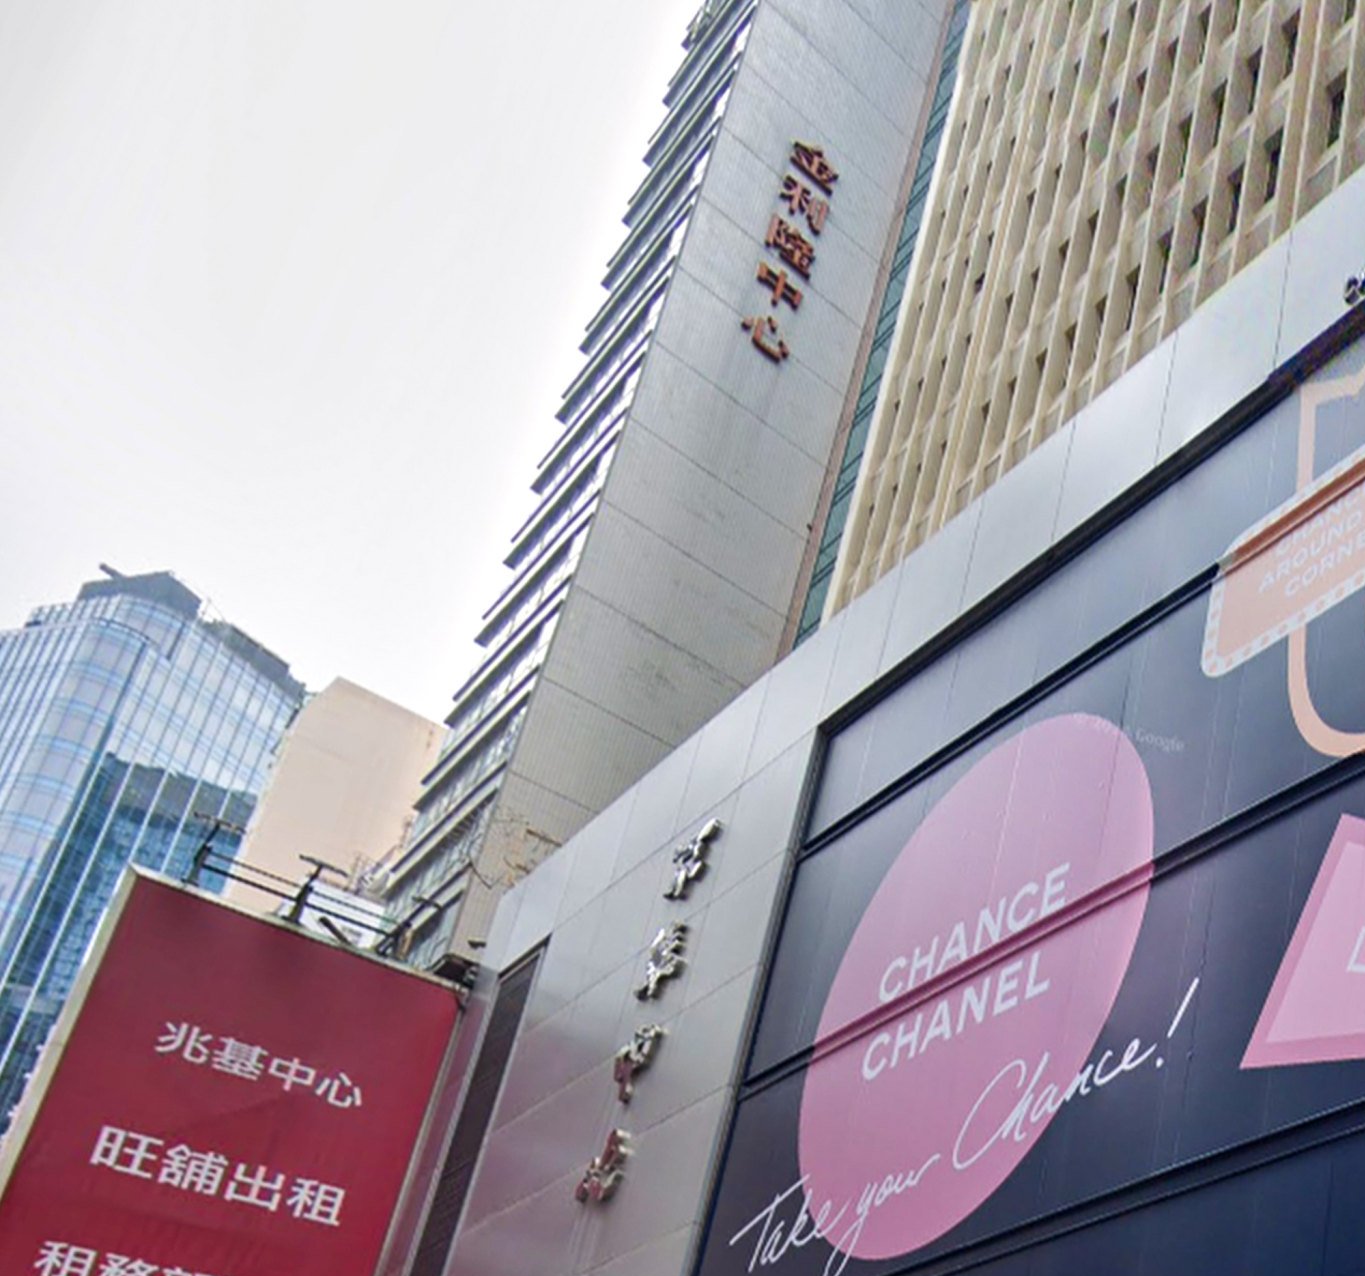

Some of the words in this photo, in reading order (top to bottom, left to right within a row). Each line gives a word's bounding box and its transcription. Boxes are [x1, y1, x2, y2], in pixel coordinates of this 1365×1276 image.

[1258, 510, 1363, 595] AROUND
[878, 862, 1071, 1003] CHANCE
[153, 1019, 364, 1110] 兆基中心
[861, 950, 1051, 1081] CHANEL
[88, 1124, 347, 1228] 旺舖出租
[729, 1172, 843, 1276] Take
[953, 976, 1200, 1171] Chance!
